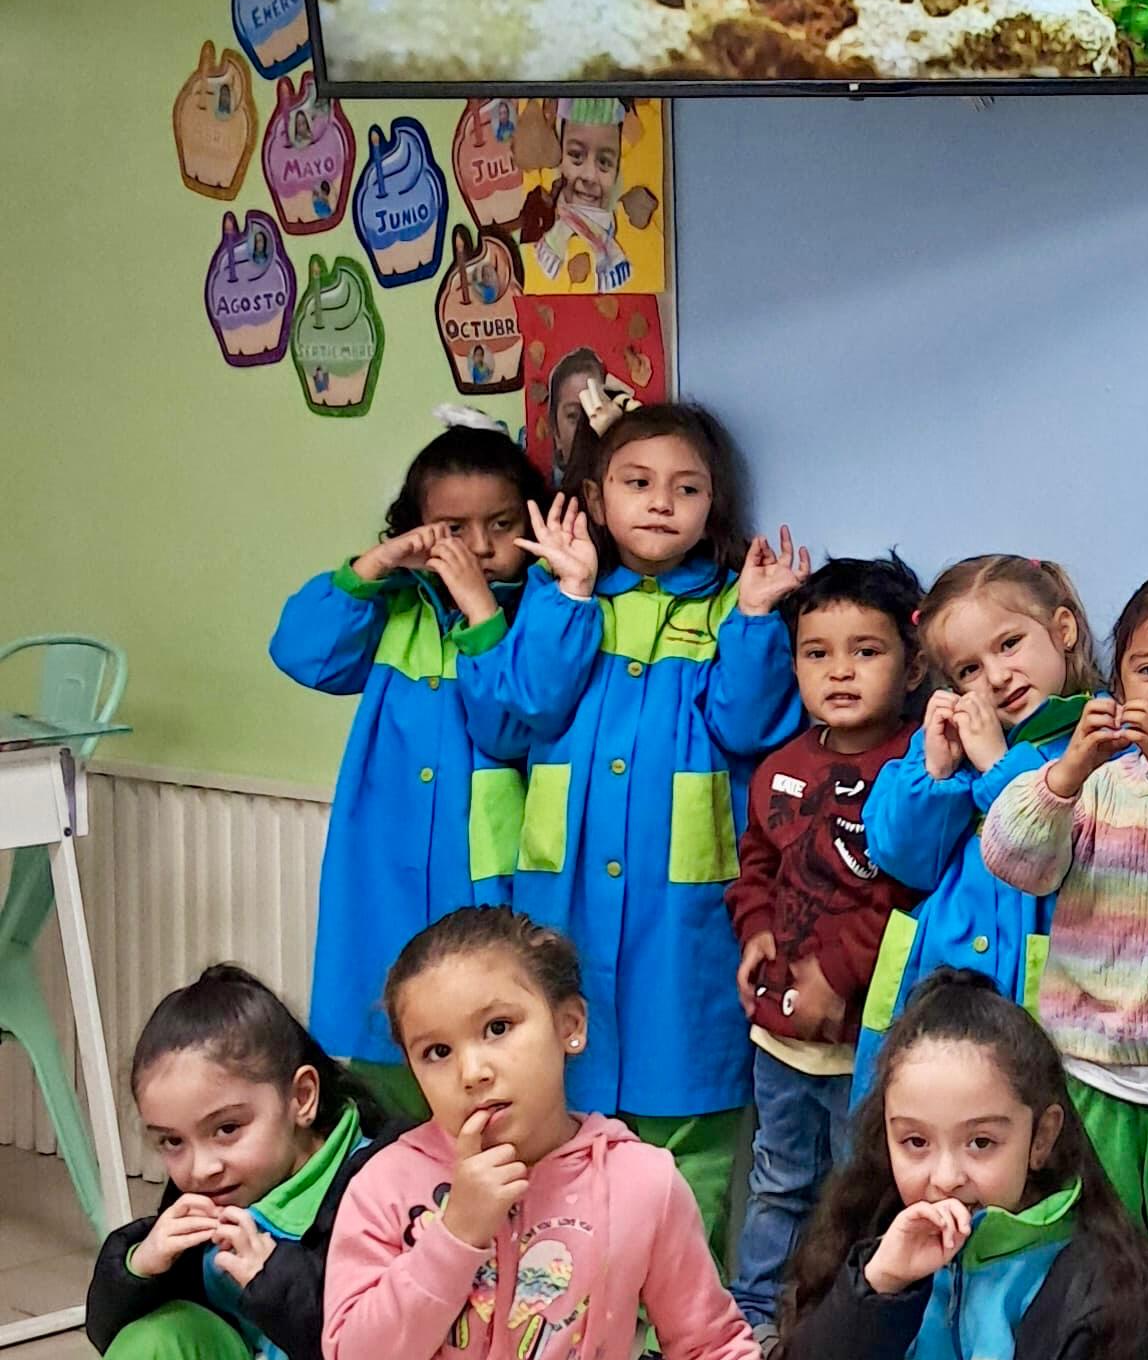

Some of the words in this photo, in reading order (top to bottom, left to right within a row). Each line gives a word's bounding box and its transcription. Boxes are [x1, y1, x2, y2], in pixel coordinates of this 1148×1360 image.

[282, 155, 335, 182] MAYO
[471, 155, 516, 183] JULI
[375, 203, 429, 233] JUNIO
[215, 290, 286, 317] AGOSTO
[445, 318, 516, 340] OCTUBR
